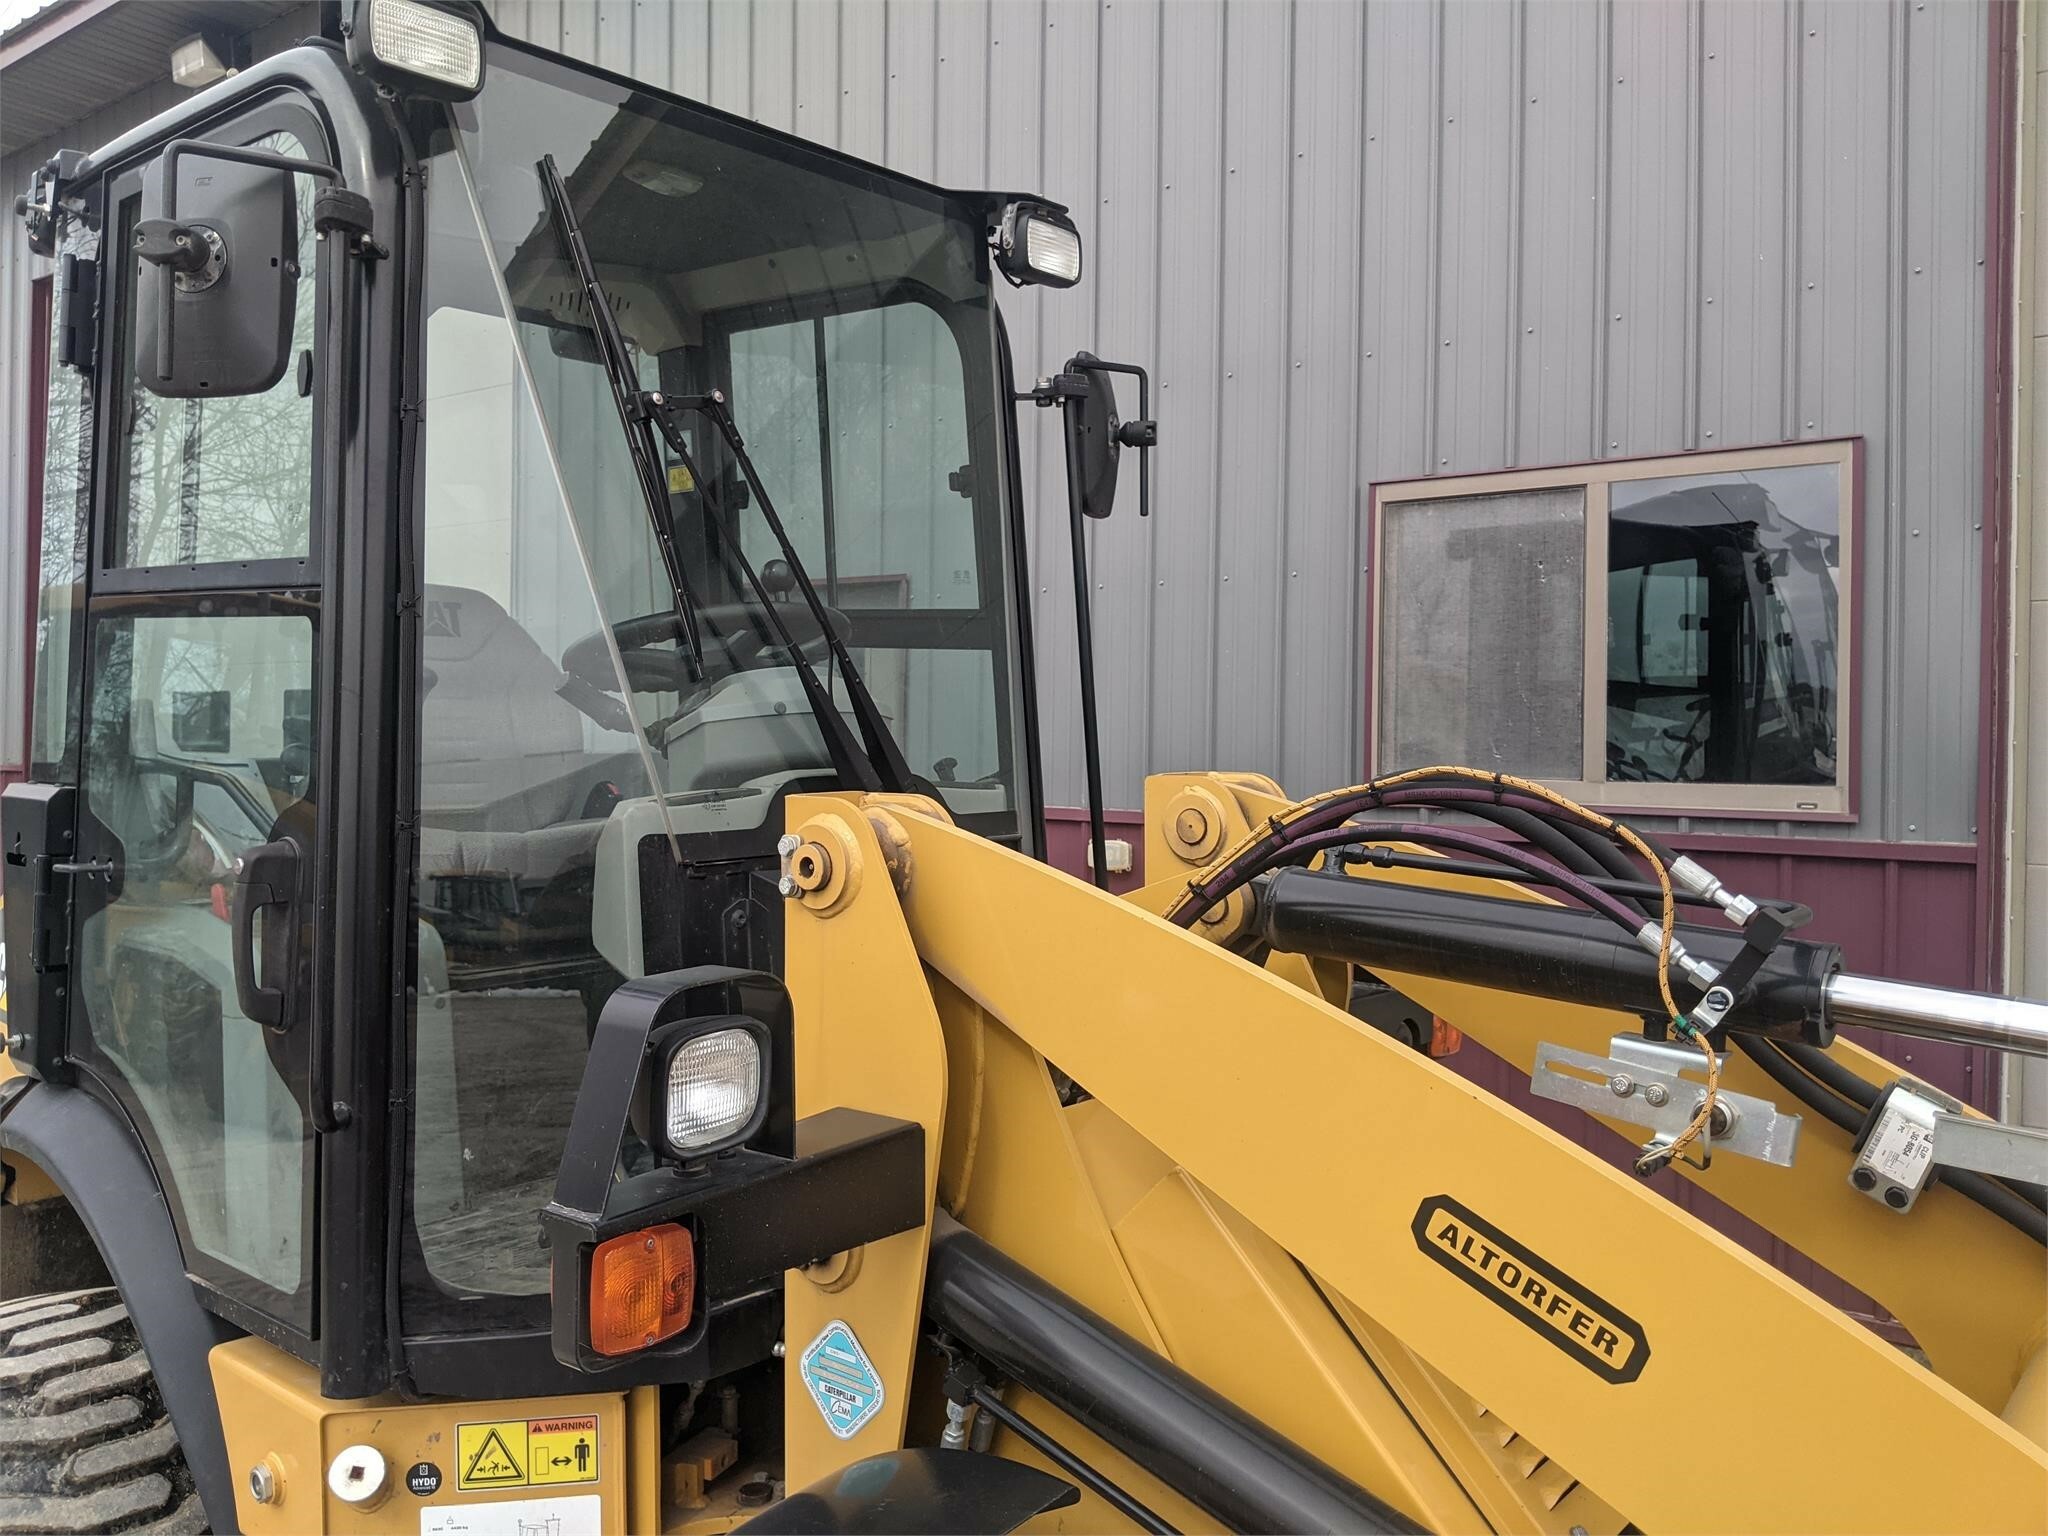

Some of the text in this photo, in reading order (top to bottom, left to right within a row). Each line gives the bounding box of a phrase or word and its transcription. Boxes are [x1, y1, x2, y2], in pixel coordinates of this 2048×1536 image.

[424, 601, 462, 638] AT
[1919, 1145, 1930, 1160] CLIP
[1437, 1223, 1619, 1358] ALTORFER
[824, 1384, 858, 1404] CATERPILLAR
[545, 1420, 593, 1432] WARNING
[412, 1477, 437, 1487] HYDO
